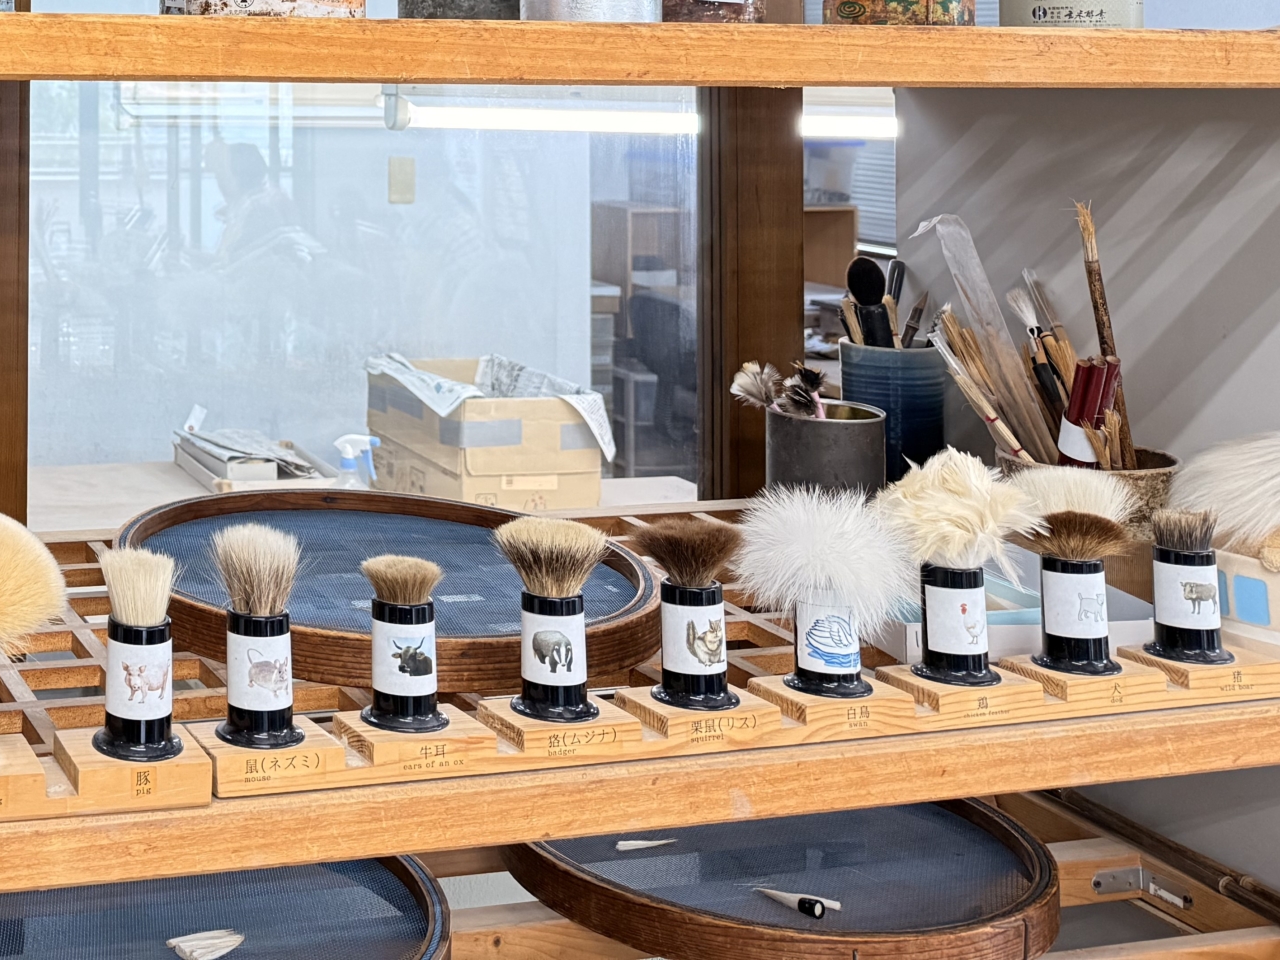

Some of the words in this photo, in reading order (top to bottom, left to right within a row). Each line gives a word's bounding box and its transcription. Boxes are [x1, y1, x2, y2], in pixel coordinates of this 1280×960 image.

[1232, 670, 1243, 684] 猪
[1111, 682, 1122, 696] 犬
[1220, 684, 1236, 692] wild
[1237, 683, 1254, 691] boar
[1110, 695, 1123, 704] dog
[847, 705, 870, 720] 白鳥
[963, 710, 986, 719] chicken
[988, 708, 1010, 717] feather
[690, 714, 757, 734] 栗鼠(リス)
[848, 720, 868, 728] swan
[690, 732, 724, 744] squirrel
[420, 744, 447, 760] 牛耳
[548, 747, 577, 757] badger
[244, 751, 320, 775] 鼠(ネズミ)
[403, 762, 421, 771] ears
[424, 761, 436, 770] of
[439, 760, 451, 768] an
[454, 758, 464, 766] ox
[135, 770, 150, 787] 豚
[244, 773, 271, 783] mouse
[136, 785, 152, 797] pig
